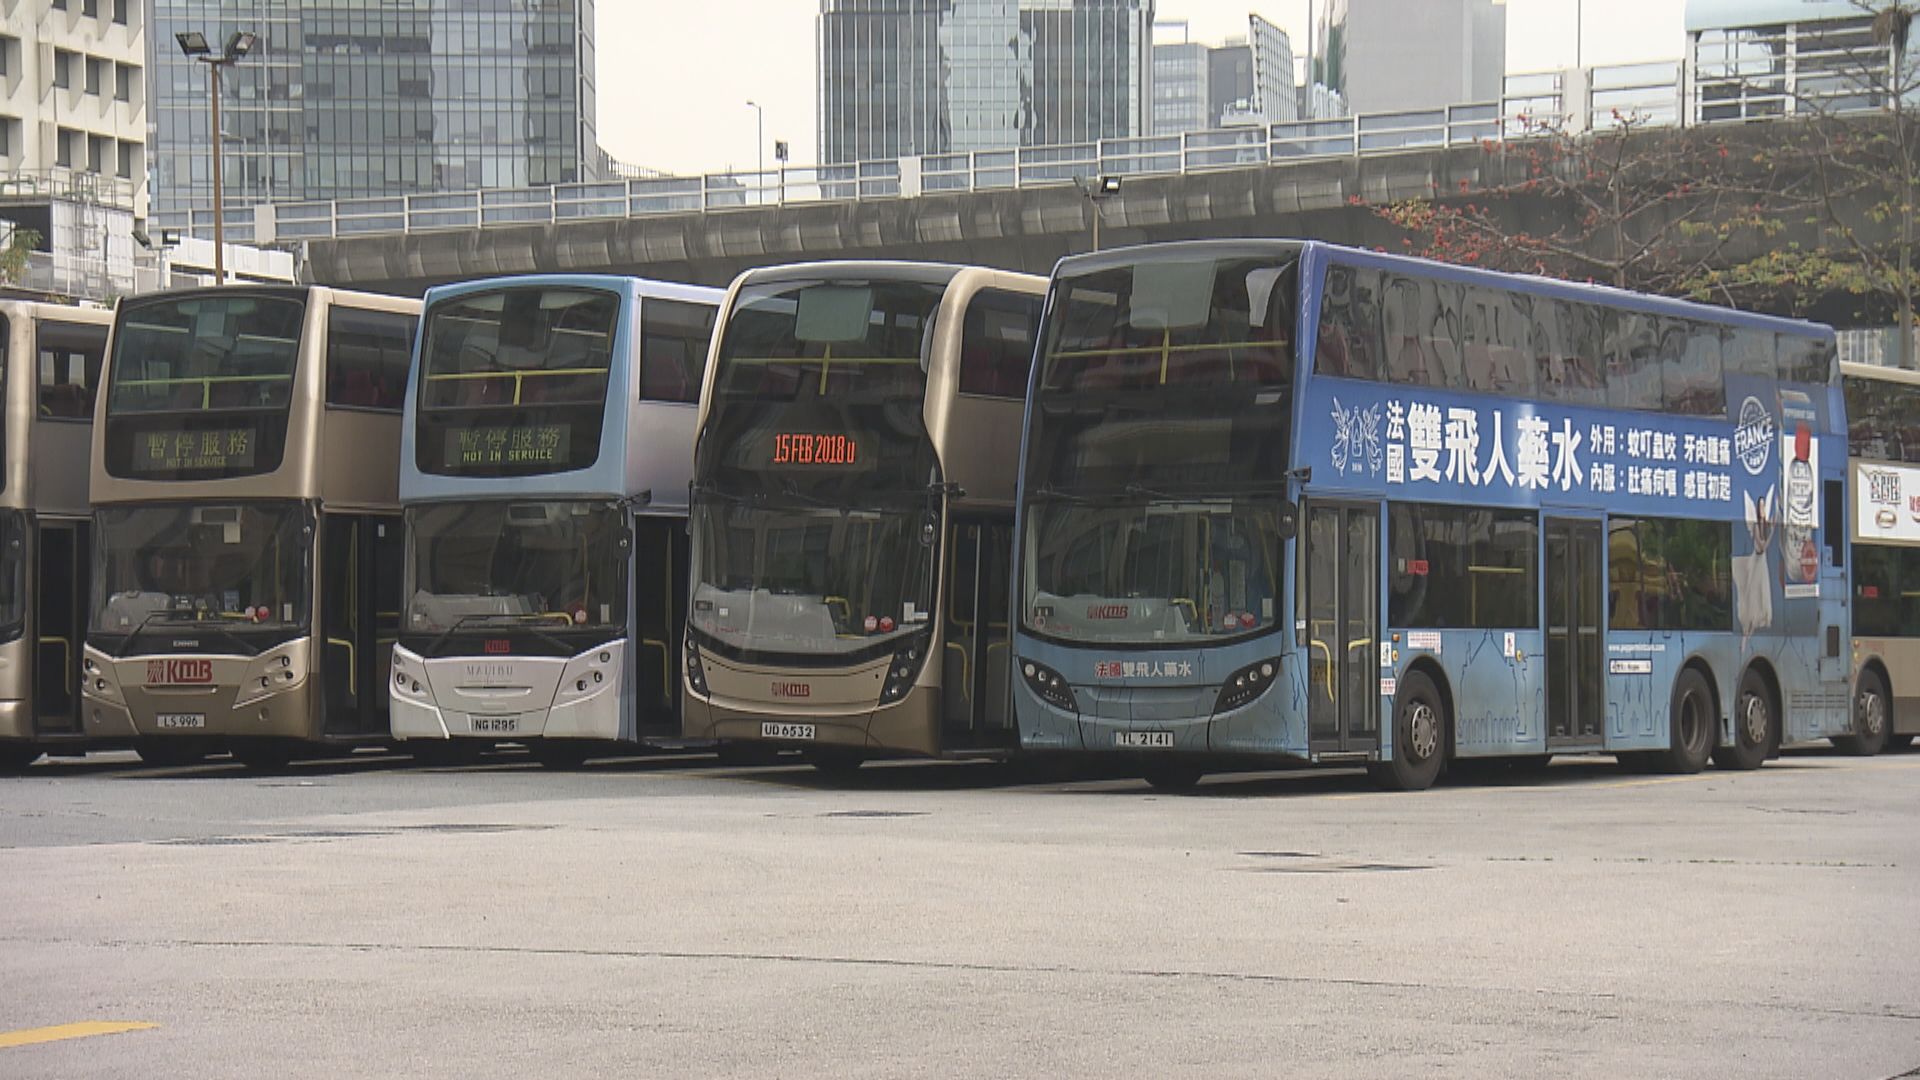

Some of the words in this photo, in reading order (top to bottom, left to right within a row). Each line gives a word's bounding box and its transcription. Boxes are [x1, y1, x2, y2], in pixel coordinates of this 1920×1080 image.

[460, 427, 560, 450] 暫停服務
[1387, 400, 1404, 483] 法國
[1734, 416, 1774, 453] FRANCE
[148, 430, 247, 459] 暫停服務
[774, 434, 790, 463] 15
[791, 434, 814, 463] FEB
[815, 434, 845, 463] 2018
[1407, 402, 1583, 491] 雙飛人藥水
[1684, 433, 1731, 465] 牙肉腫痛
[195, 455, 227, 468] SERVICE
[463, 450, 482, 462] NOT
[490, 449, 501, 461] IN
[508, 447, 553, 461] SERVICE
[1684, 470, 1731, 501] 感冒初起
[1099, 604, 1129, 619] KMB
[485, 640, 511, 653] KMB
[167, 659, 213, 683] KMB
[782, 682, 810, 697] KMB
[164, 716, 177, 727] LS
[180, 715, 198, 727] 996
[475, 719, 489, 731] NG
[491, 719, 515, 732] 1295
[764, 723, 780, 735] UD
[782, 725, 812, 738] 6532
[1140, 733, 1169, 746] 2141
